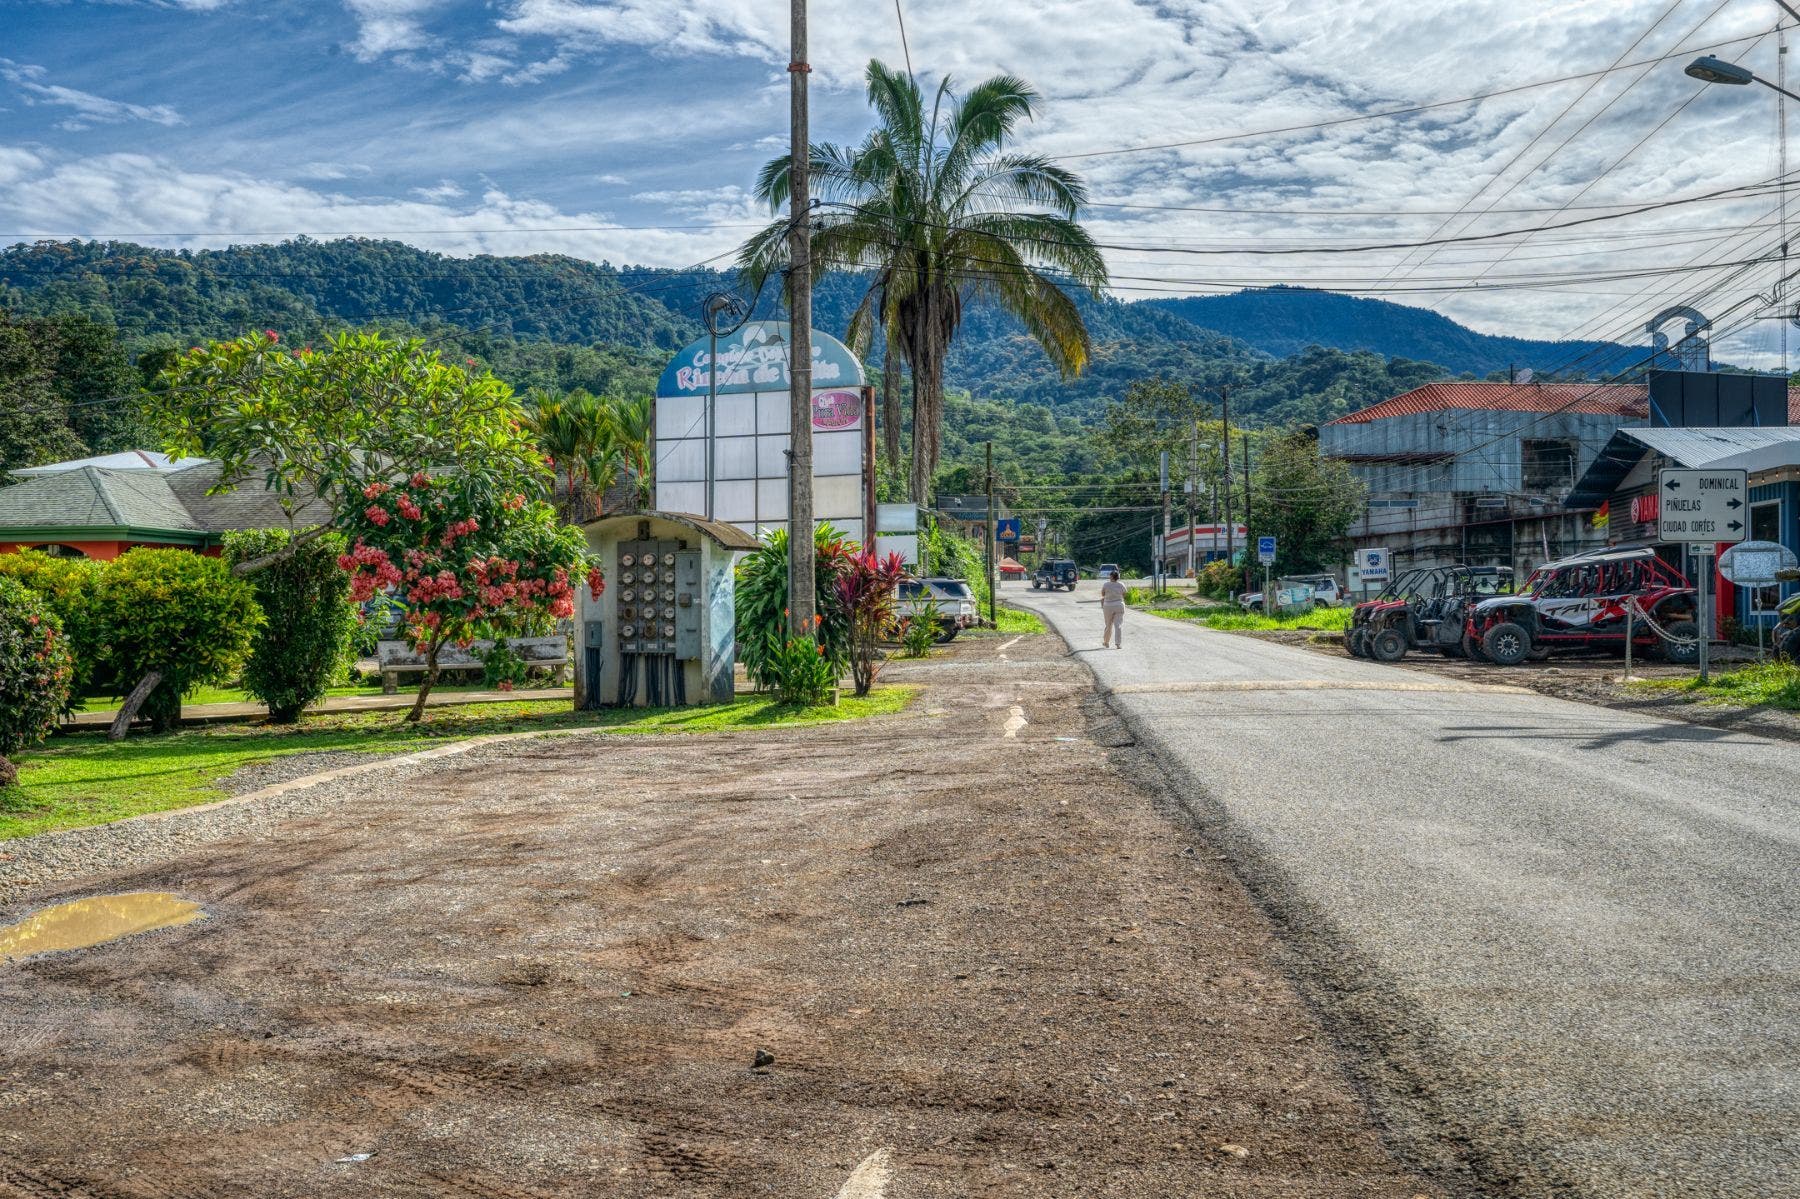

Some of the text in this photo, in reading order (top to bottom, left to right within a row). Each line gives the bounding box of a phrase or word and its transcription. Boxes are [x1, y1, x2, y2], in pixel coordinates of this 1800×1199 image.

[1699, 478, 1739, 490] DOMINICAL
[1666, 497, 1701, 511] PIÑUELAS
[1662, 518, 1715, 533] CIUDAD CORTÉS
[1361, 568, 1387, 576] YAMAHA
